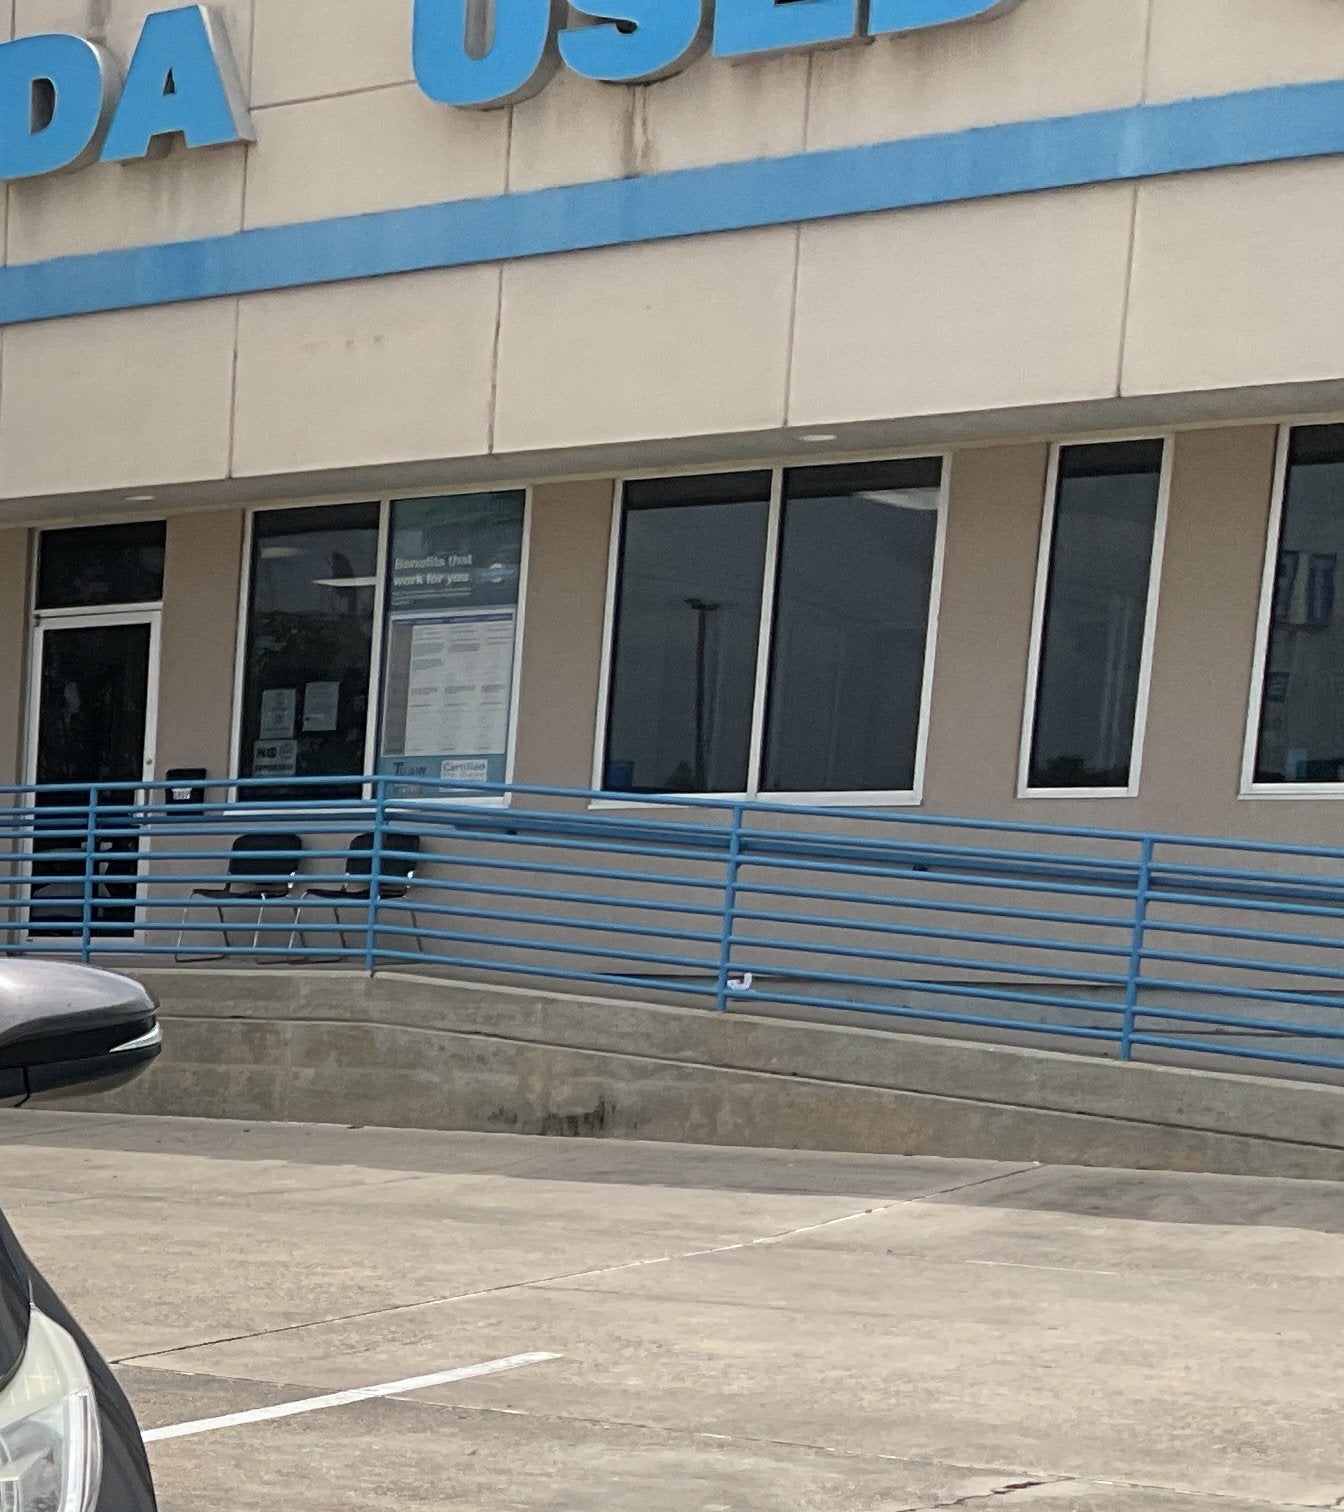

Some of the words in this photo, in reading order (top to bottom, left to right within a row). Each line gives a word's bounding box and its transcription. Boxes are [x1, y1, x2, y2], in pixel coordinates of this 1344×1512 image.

[412, 0, 1012, 107] US
[448, 553, 472, 567] that
[393, 573, 424, 586] work
[426, 572, 444, 584] for
